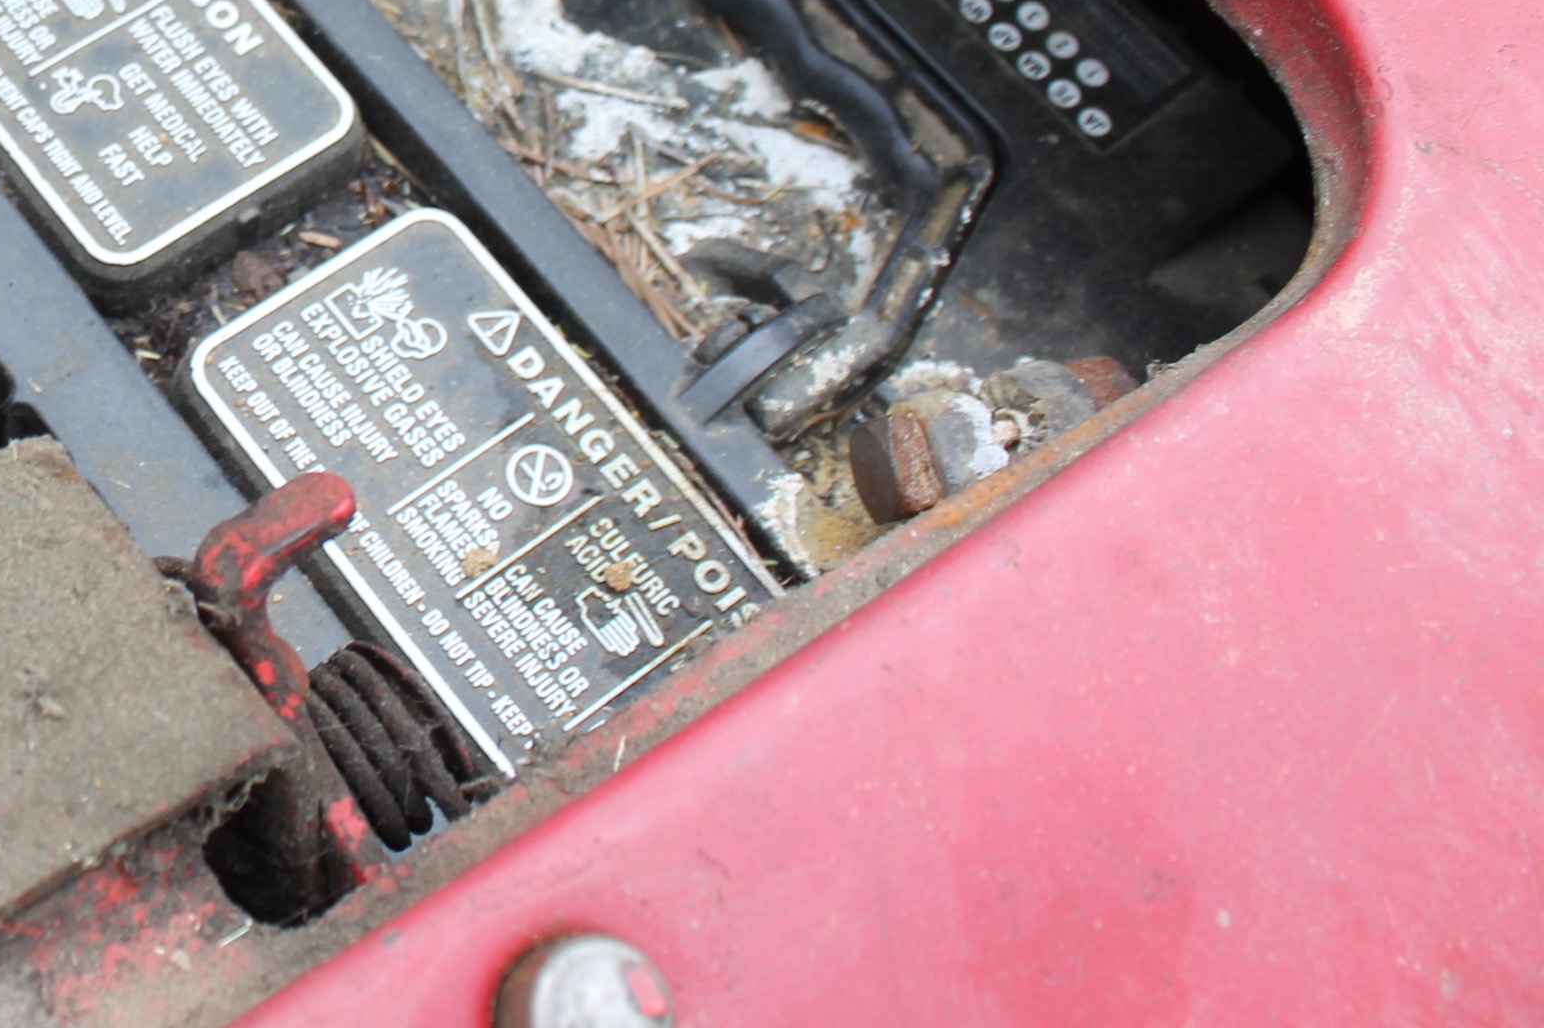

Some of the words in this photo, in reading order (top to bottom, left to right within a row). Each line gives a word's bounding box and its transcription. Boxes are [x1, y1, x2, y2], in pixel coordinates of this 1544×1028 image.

[26, 24, 57, 51] OR
[148, 4, 205, 61] FLUSH
[191, 54, 241, 102] EYES
[228, 96, 279, 146] WITH
[116, 61, 157, 97] GET
[142, 91, 209, 163] MEDICAL
[126, 16, 183, 74] WATER
[169, 67, 266, 169] IMMEDIATELY
[126, 124, 174, 168] HELP
[15, 105, 54, 144] CAPS
[41, 137, 83, 178] TIGHT
[68, 172, 103, 204] AND
[97, 142, 145, 187] FAST
[217, 354, 258, 393] KEEP
[245, 390, 280, 423] OUT
[267, 418, 296, 441] OF
[282, 435, 317, 469] THE
[250, 331, 283, 362] OR
[270, 355, 353, 447] BLINDNESS
[270, 319, 310, 358] CAN
[296, 352, 352, 409] CAUSE
[336, 402, 398, 464] INJURY
[298, 301, 396, 407] EXPLOSIVE
[381, 401, 446, 468] GASES
[358, 333, 426, 404] SHIELD
[413, 398, 467, 453] EYES
[394, 505, 467, 587] SMOKING
[415, 492, 479, 560] FLAMES
[434, 478, 499, 547] SPARKS
[475, 485, 514, 522] NO
[357, 529, 426, 605] CHILDREN
[420, 607, 451, 636] DO
[437, 629, 476, 667] NOT
[462, 659, 495, 690] TIP
[490, 694, 534, 738] KEEP
[462, 589, 526, 659] SEVERE
[513, 651, 577, 719] INJURY
[483, 575, 569, 671] BLINDNESS
[556, 665, 590, 698] OR
[503, 562, 544, 602] CAN
[531, 596, 589, 656] CAUSE
